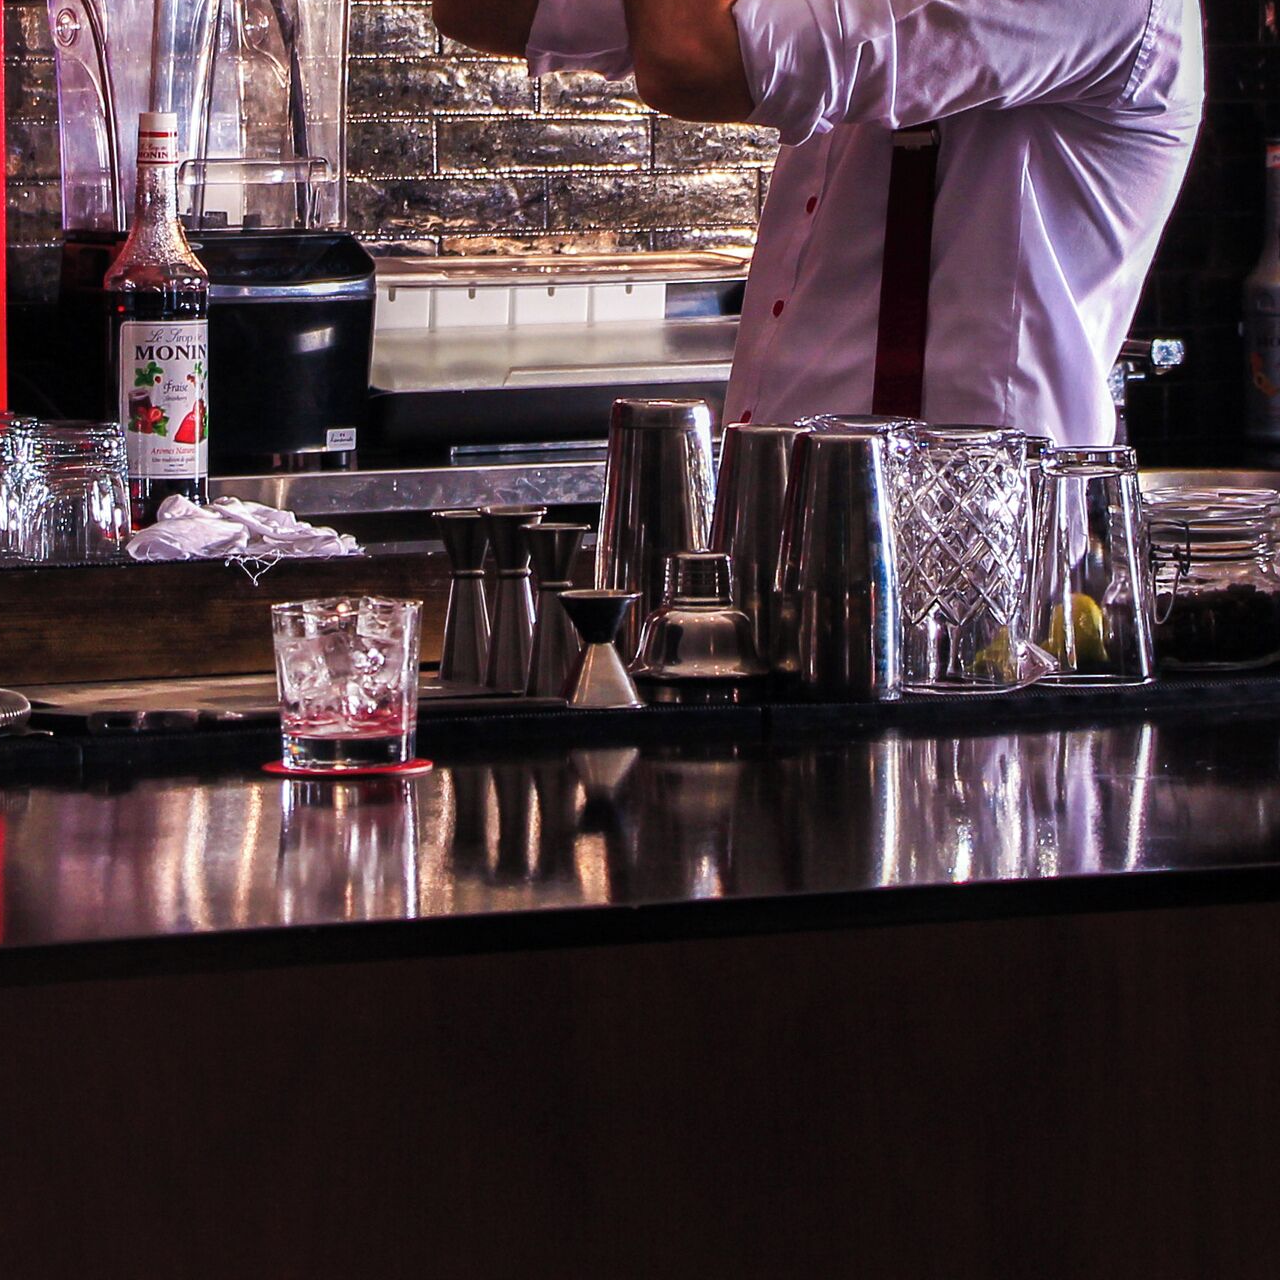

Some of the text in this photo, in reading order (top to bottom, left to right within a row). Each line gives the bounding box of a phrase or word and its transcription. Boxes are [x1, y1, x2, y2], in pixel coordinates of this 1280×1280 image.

[145, 329, 164, 343] Le
[166, 328, 193, 346] Sirop
[135, 344, 207, 361] MONIN
[163, 380, 189, 395] Fraise
